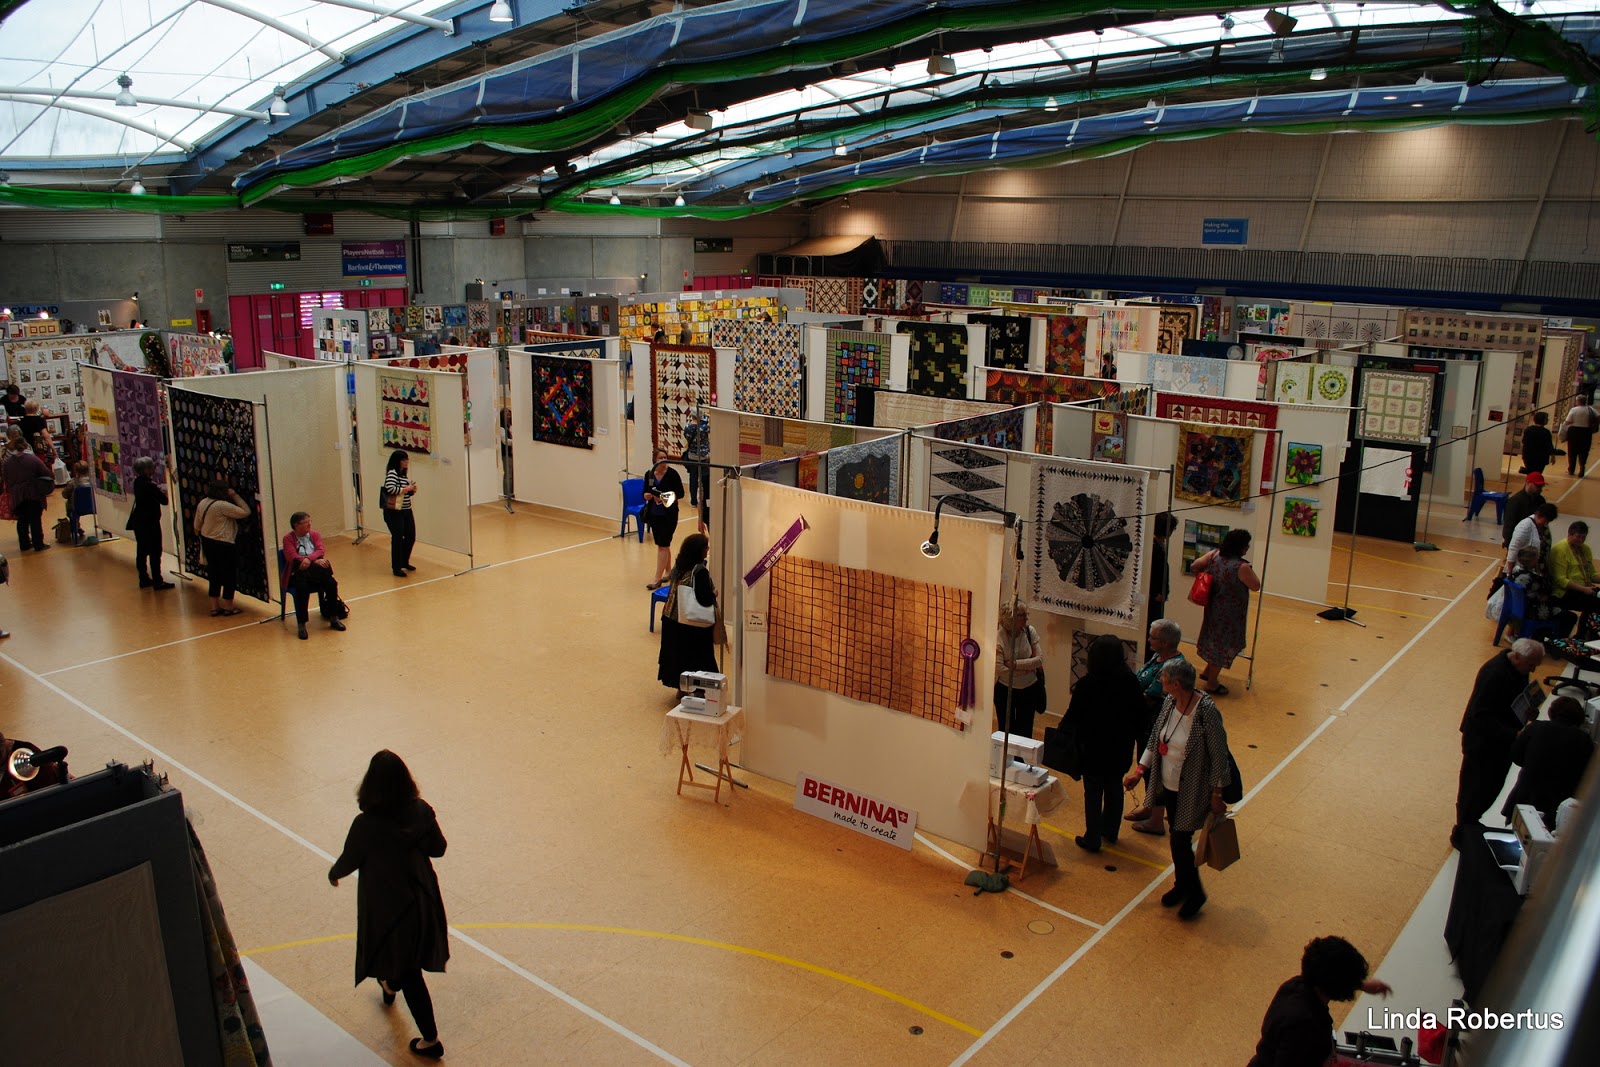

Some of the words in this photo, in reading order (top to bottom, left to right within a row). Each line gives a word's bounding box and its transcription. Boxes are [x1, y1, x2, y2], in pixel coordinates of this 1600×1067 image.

[803, 777, 898, 829] BERNINA
[833, 810, 858, 827] made
[859, 819, 869, 830] to
[870, 825, 897, 841] create
